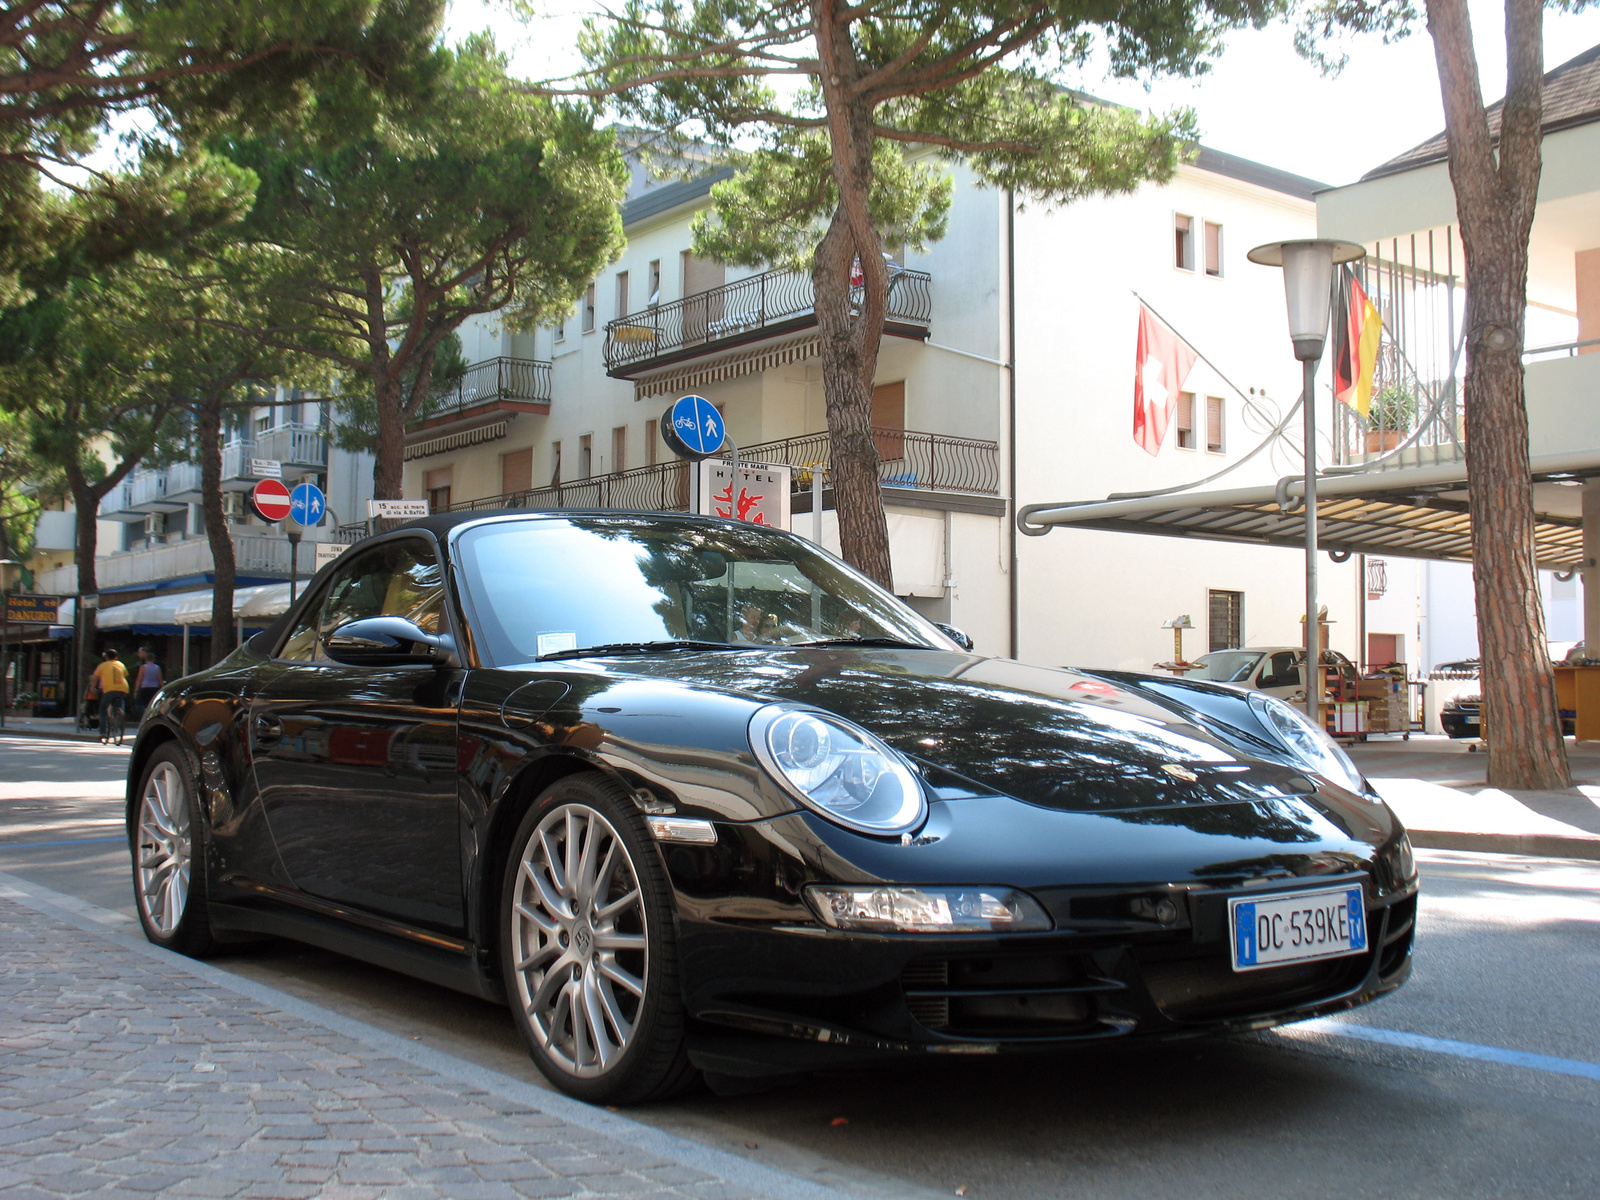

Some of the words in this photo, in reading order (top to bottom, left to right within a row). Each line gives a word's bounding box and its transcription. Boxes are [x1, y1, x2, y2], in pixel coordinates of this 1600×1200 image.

[750, 462, 769, 470] MARE
[716, 471, 774, 483] HTEL
[8, 597, 36, 607] Hotel
[7, 609, 56, 621] DANUBIO
[1291, 905, 1349, 947] 539KE
[1350, 917, 1361, 940] TV
